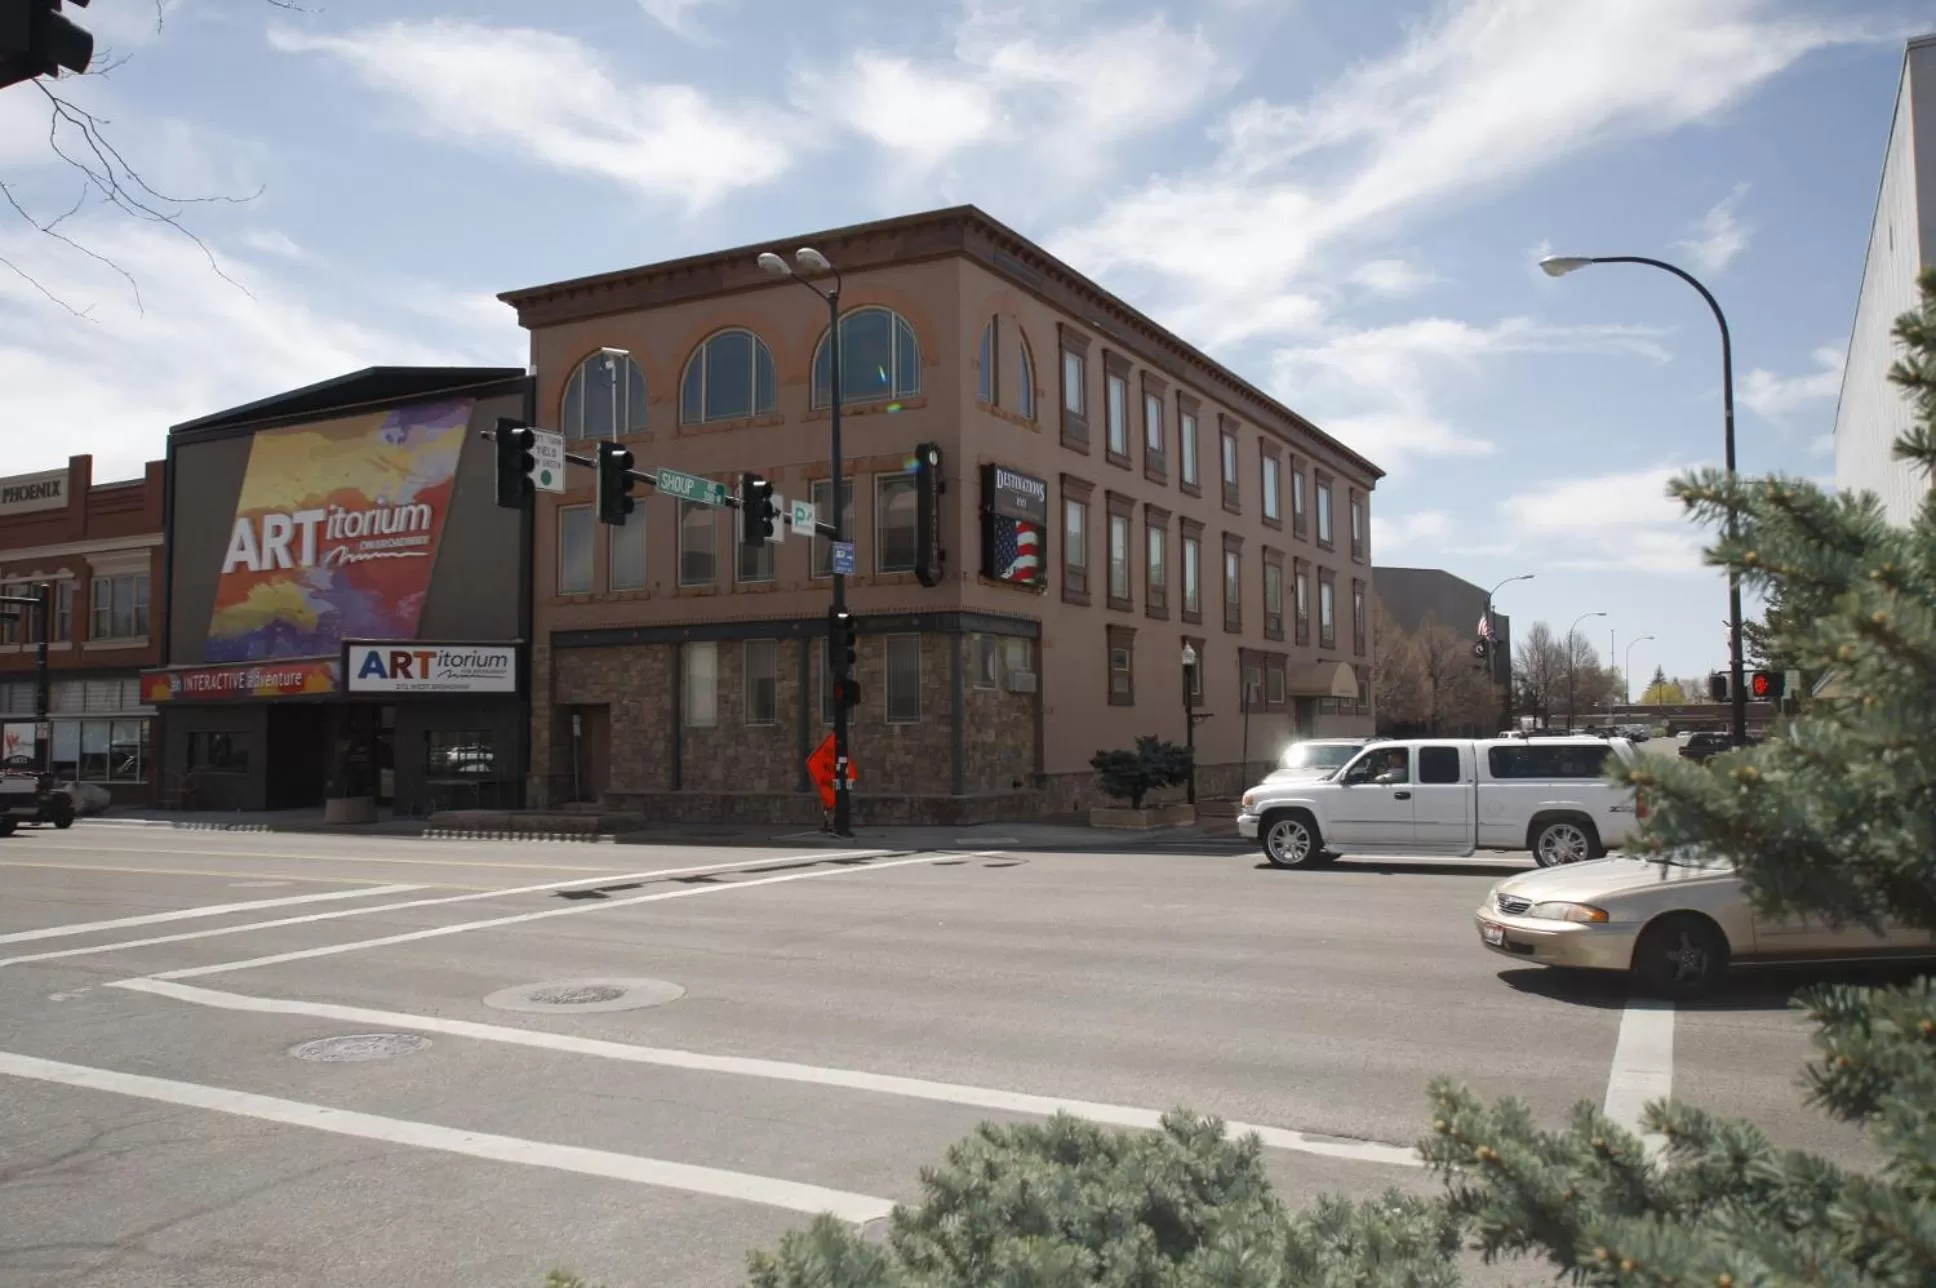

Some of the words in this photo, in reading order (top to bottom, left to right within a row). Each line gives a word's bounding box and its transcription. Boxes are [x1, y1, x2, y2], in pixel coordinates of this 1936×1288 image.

[536, 446, 557, 458] YIELD
[1, 479, 61, 504] PHOENIX
[660, 471, 695, 497] SHOUP
[997, 469, 1045, 502] DESTINATIONS
[183, 671, 246, 692] INTERACTIVE
[247, 670, 303, 688] adventure
